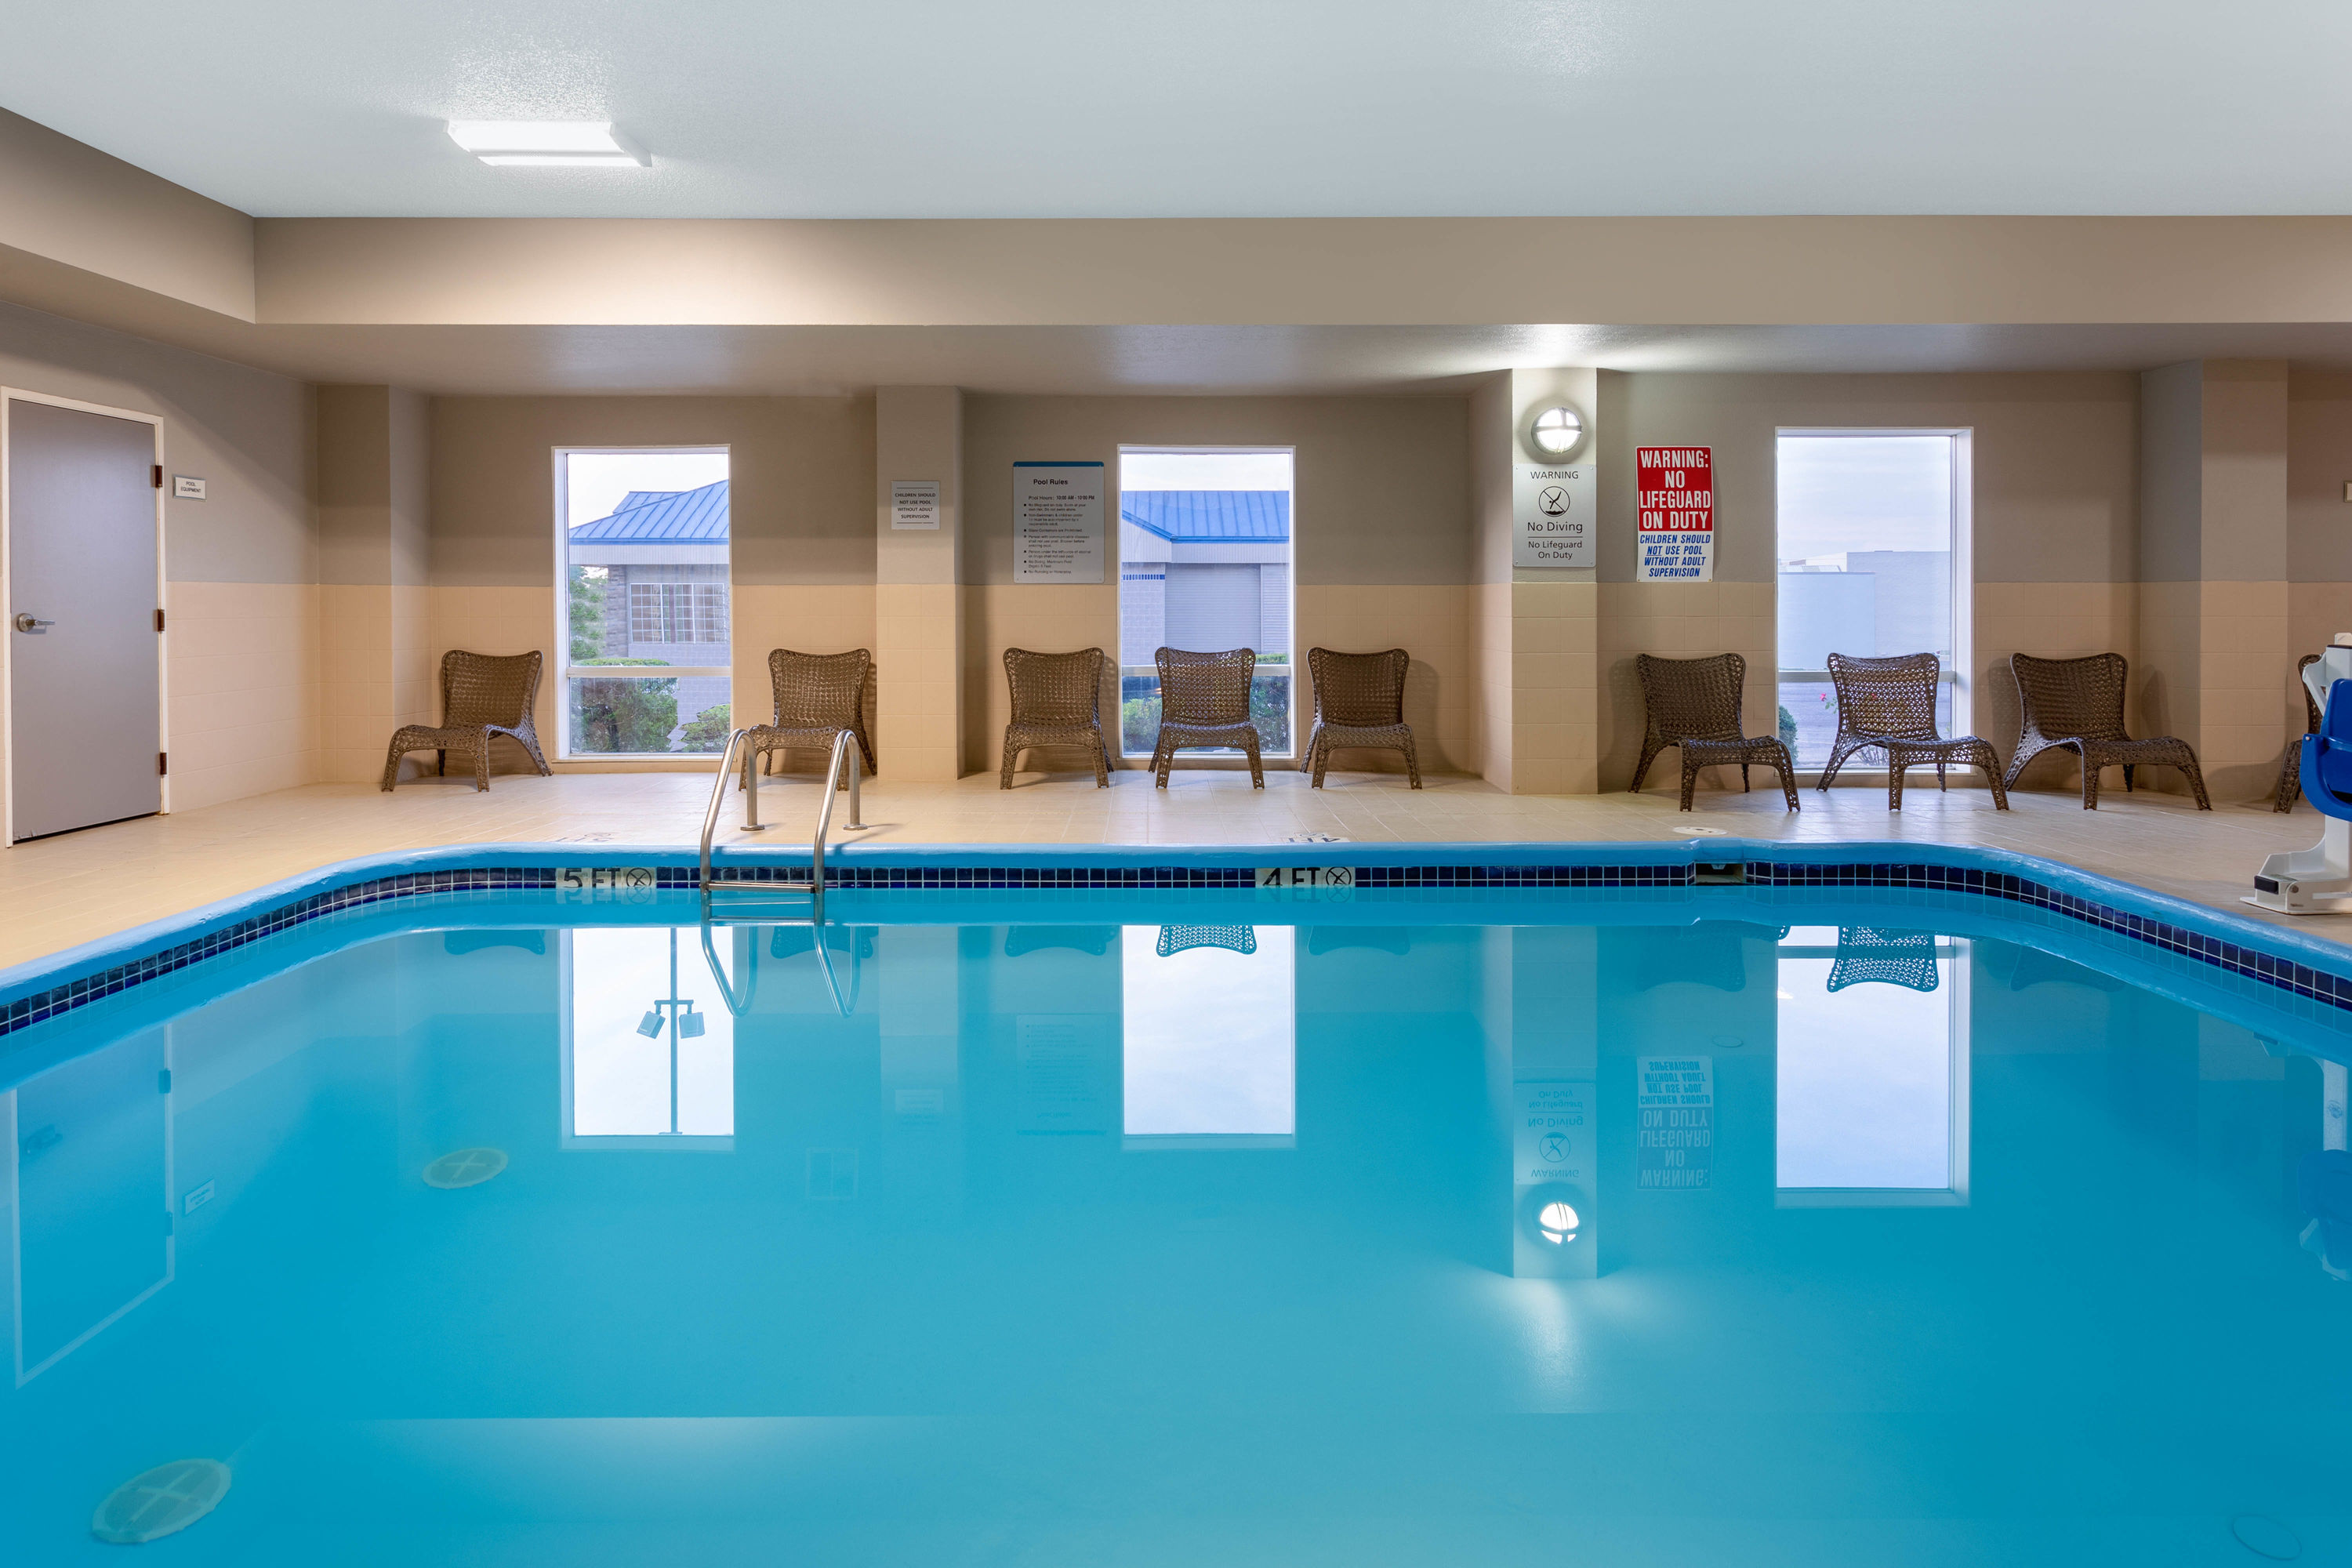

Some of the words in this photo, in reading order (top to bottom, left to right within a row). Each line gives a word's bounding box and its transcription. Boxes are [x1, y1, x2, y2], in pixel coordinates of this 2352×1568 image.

[1640, 450, 1708, 468] WARNING:
[1665, 470, 1685, 488] NO
[1640, 491, 1711, 508] LIFEGUARD
[1643, 511, 1663, 529] ON
[1670, 511, 1708, 529] DUTY
[1528, 522, 1543, 531] No
[1547, 522, 1583, 533] Diving
[1640, 535, 1678, 544] CHILDREN
[1681, 535, 1710, 544] SHOULD
[1543, 541, 1582, 550] Lifeguard
[1647, 546, 1663, 555] NOT
[1666, 546, 1680, 555] USE
[1683, 546, 1702, 555] POOL
[1553, 552, 1573, 560] Duty
[1644, 557, 1679, 566] WITHOUT
[1682, 557, 1706, 566] ADULT
[1649, 568, 1700, 577] SUPERVISION
[564, 868, 583, 887] 5
[592, 868, 621, 887] FT
[1263, 867, 1283, 886] 4
[1292, 867, 1321, 886] FT
